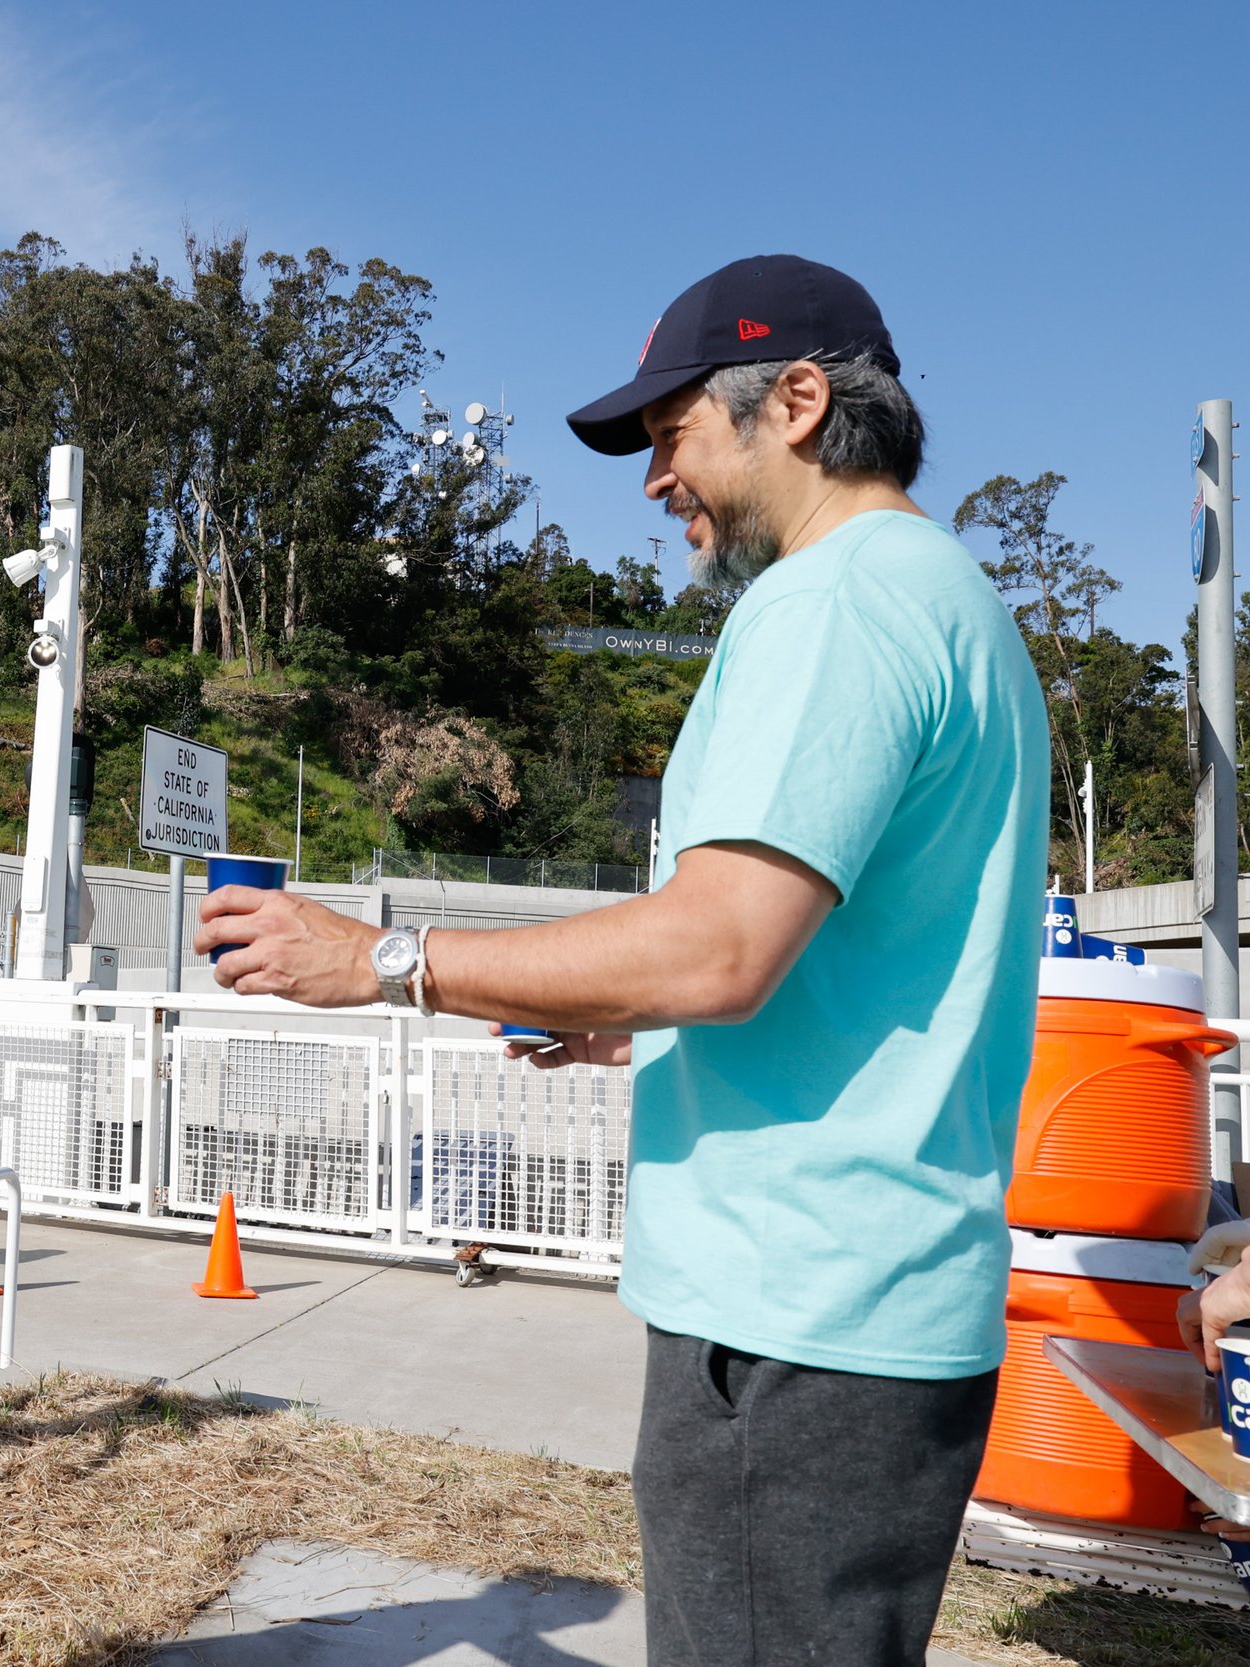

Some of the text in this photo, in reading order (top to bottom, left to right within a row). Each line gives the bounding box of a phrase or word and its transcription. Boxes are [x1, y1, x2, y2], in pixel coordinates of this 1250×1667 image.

[177, 748, 197, 770] END
[163, 771, 209, 799] STATE OF
[157, 795, 215, 826] CALIFORNIA
[151, 822, 220, 852] JURISDICTION
